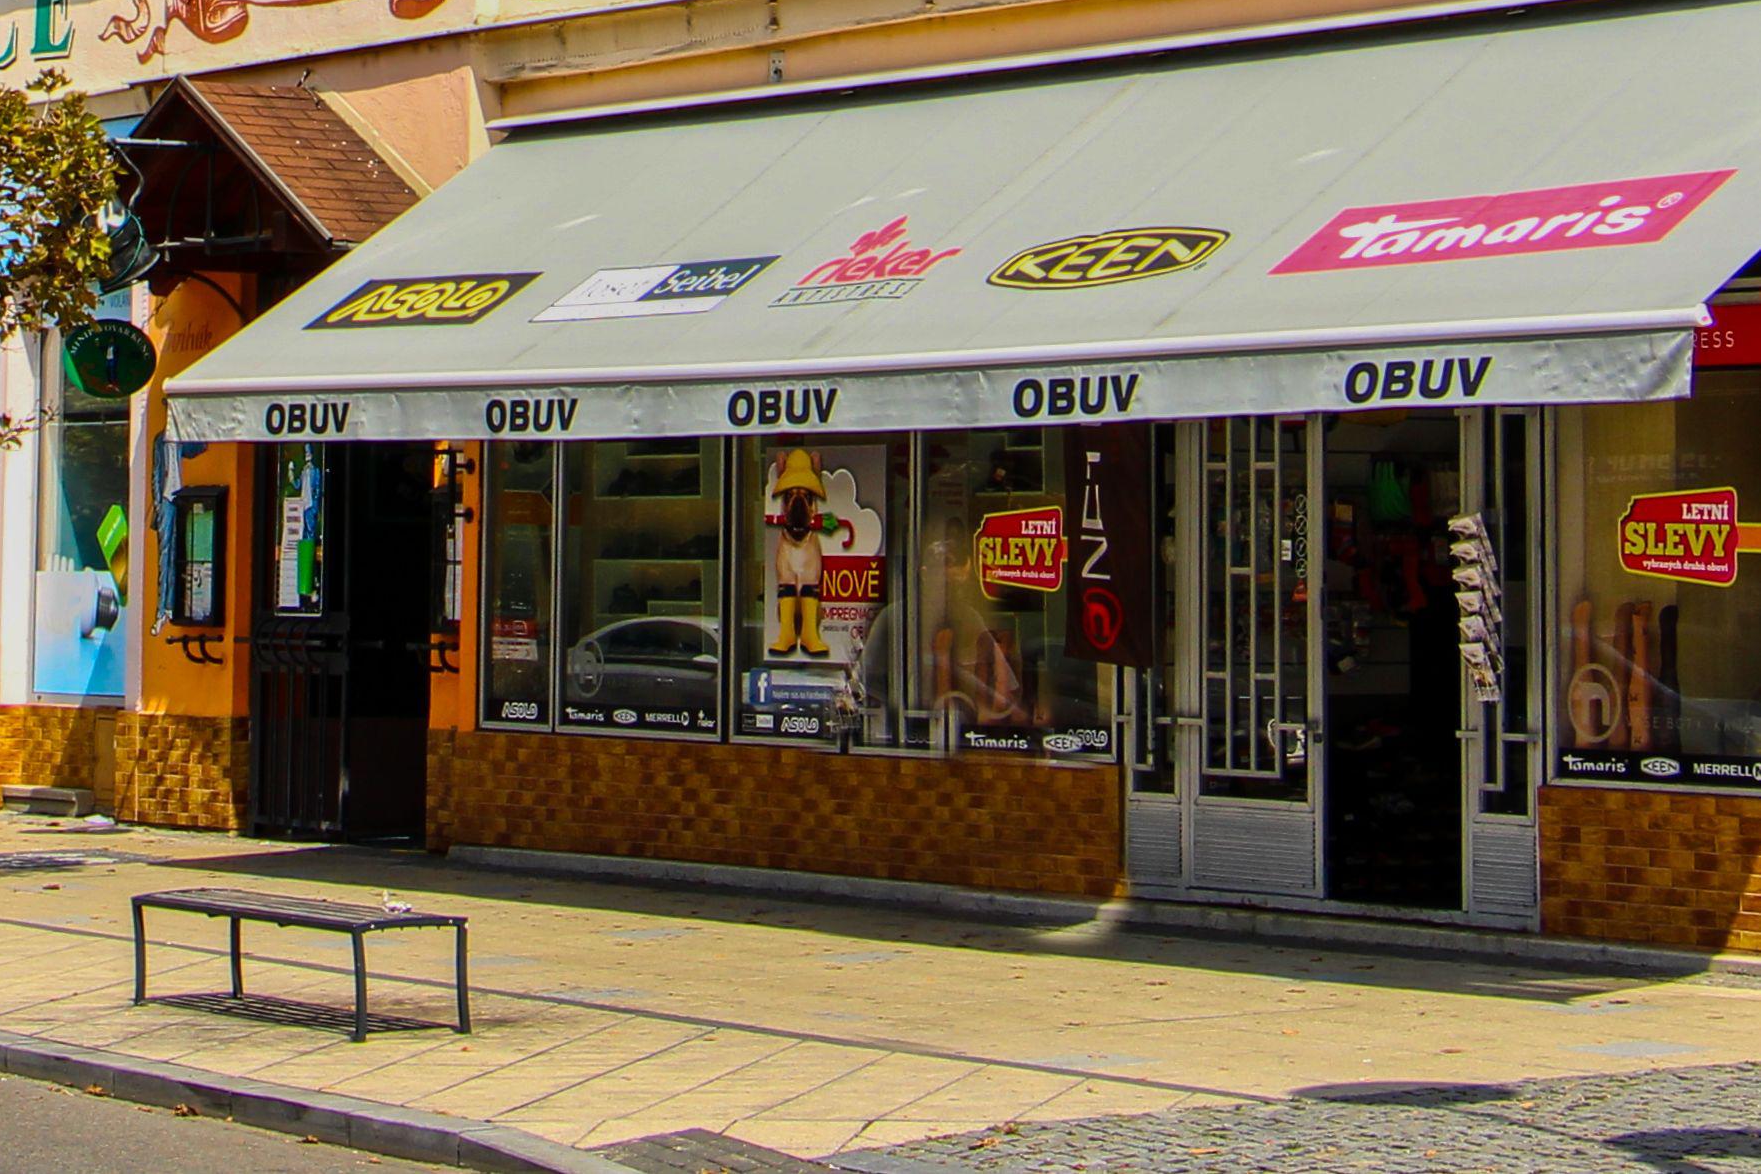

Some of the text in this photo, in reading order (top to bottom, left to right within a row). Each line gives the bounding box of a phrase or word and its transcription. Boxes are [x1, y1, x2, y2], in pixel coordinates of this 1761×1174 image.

[1339, 195, 1651, 259] Tamaris
[796, 241, 963, 285] rieker
[1003, 235, 1213, 281] KEEN
[654, 265, 761, 294] Seibel
[326, 280, 510, 323] ASOLO
[1013, 374, 1140, 418] OBUV
[1344, 356, 1493, 403] OBUV
[265, 402, 350, 435] OBUV
[485, 397, 578, 434] OBUV
[727, 388, 837, 426] OBUV
[1021, 517, 1056, 534] LETNÍ
[1682, 500, 1729, 520] LETNÍ
[980, 537, 1057, 566] SLEVY
[1624, 521, 1730, 557] SLEVY
[823, 561, 880, 597] NOVĚ
[502, 702, 538, 720] ASOLO
[566, 707, 605, 722] Tamaris
[645, 712, 680, 724] MERRELL
[781, 716, 820, 733] ASOLO
[965, 731, 1028, 749] Tamaris
[1045, 735, 1081, 751] KEEN
[1562, 754, 1753, 777] Tamaris KEEN MERRELL
